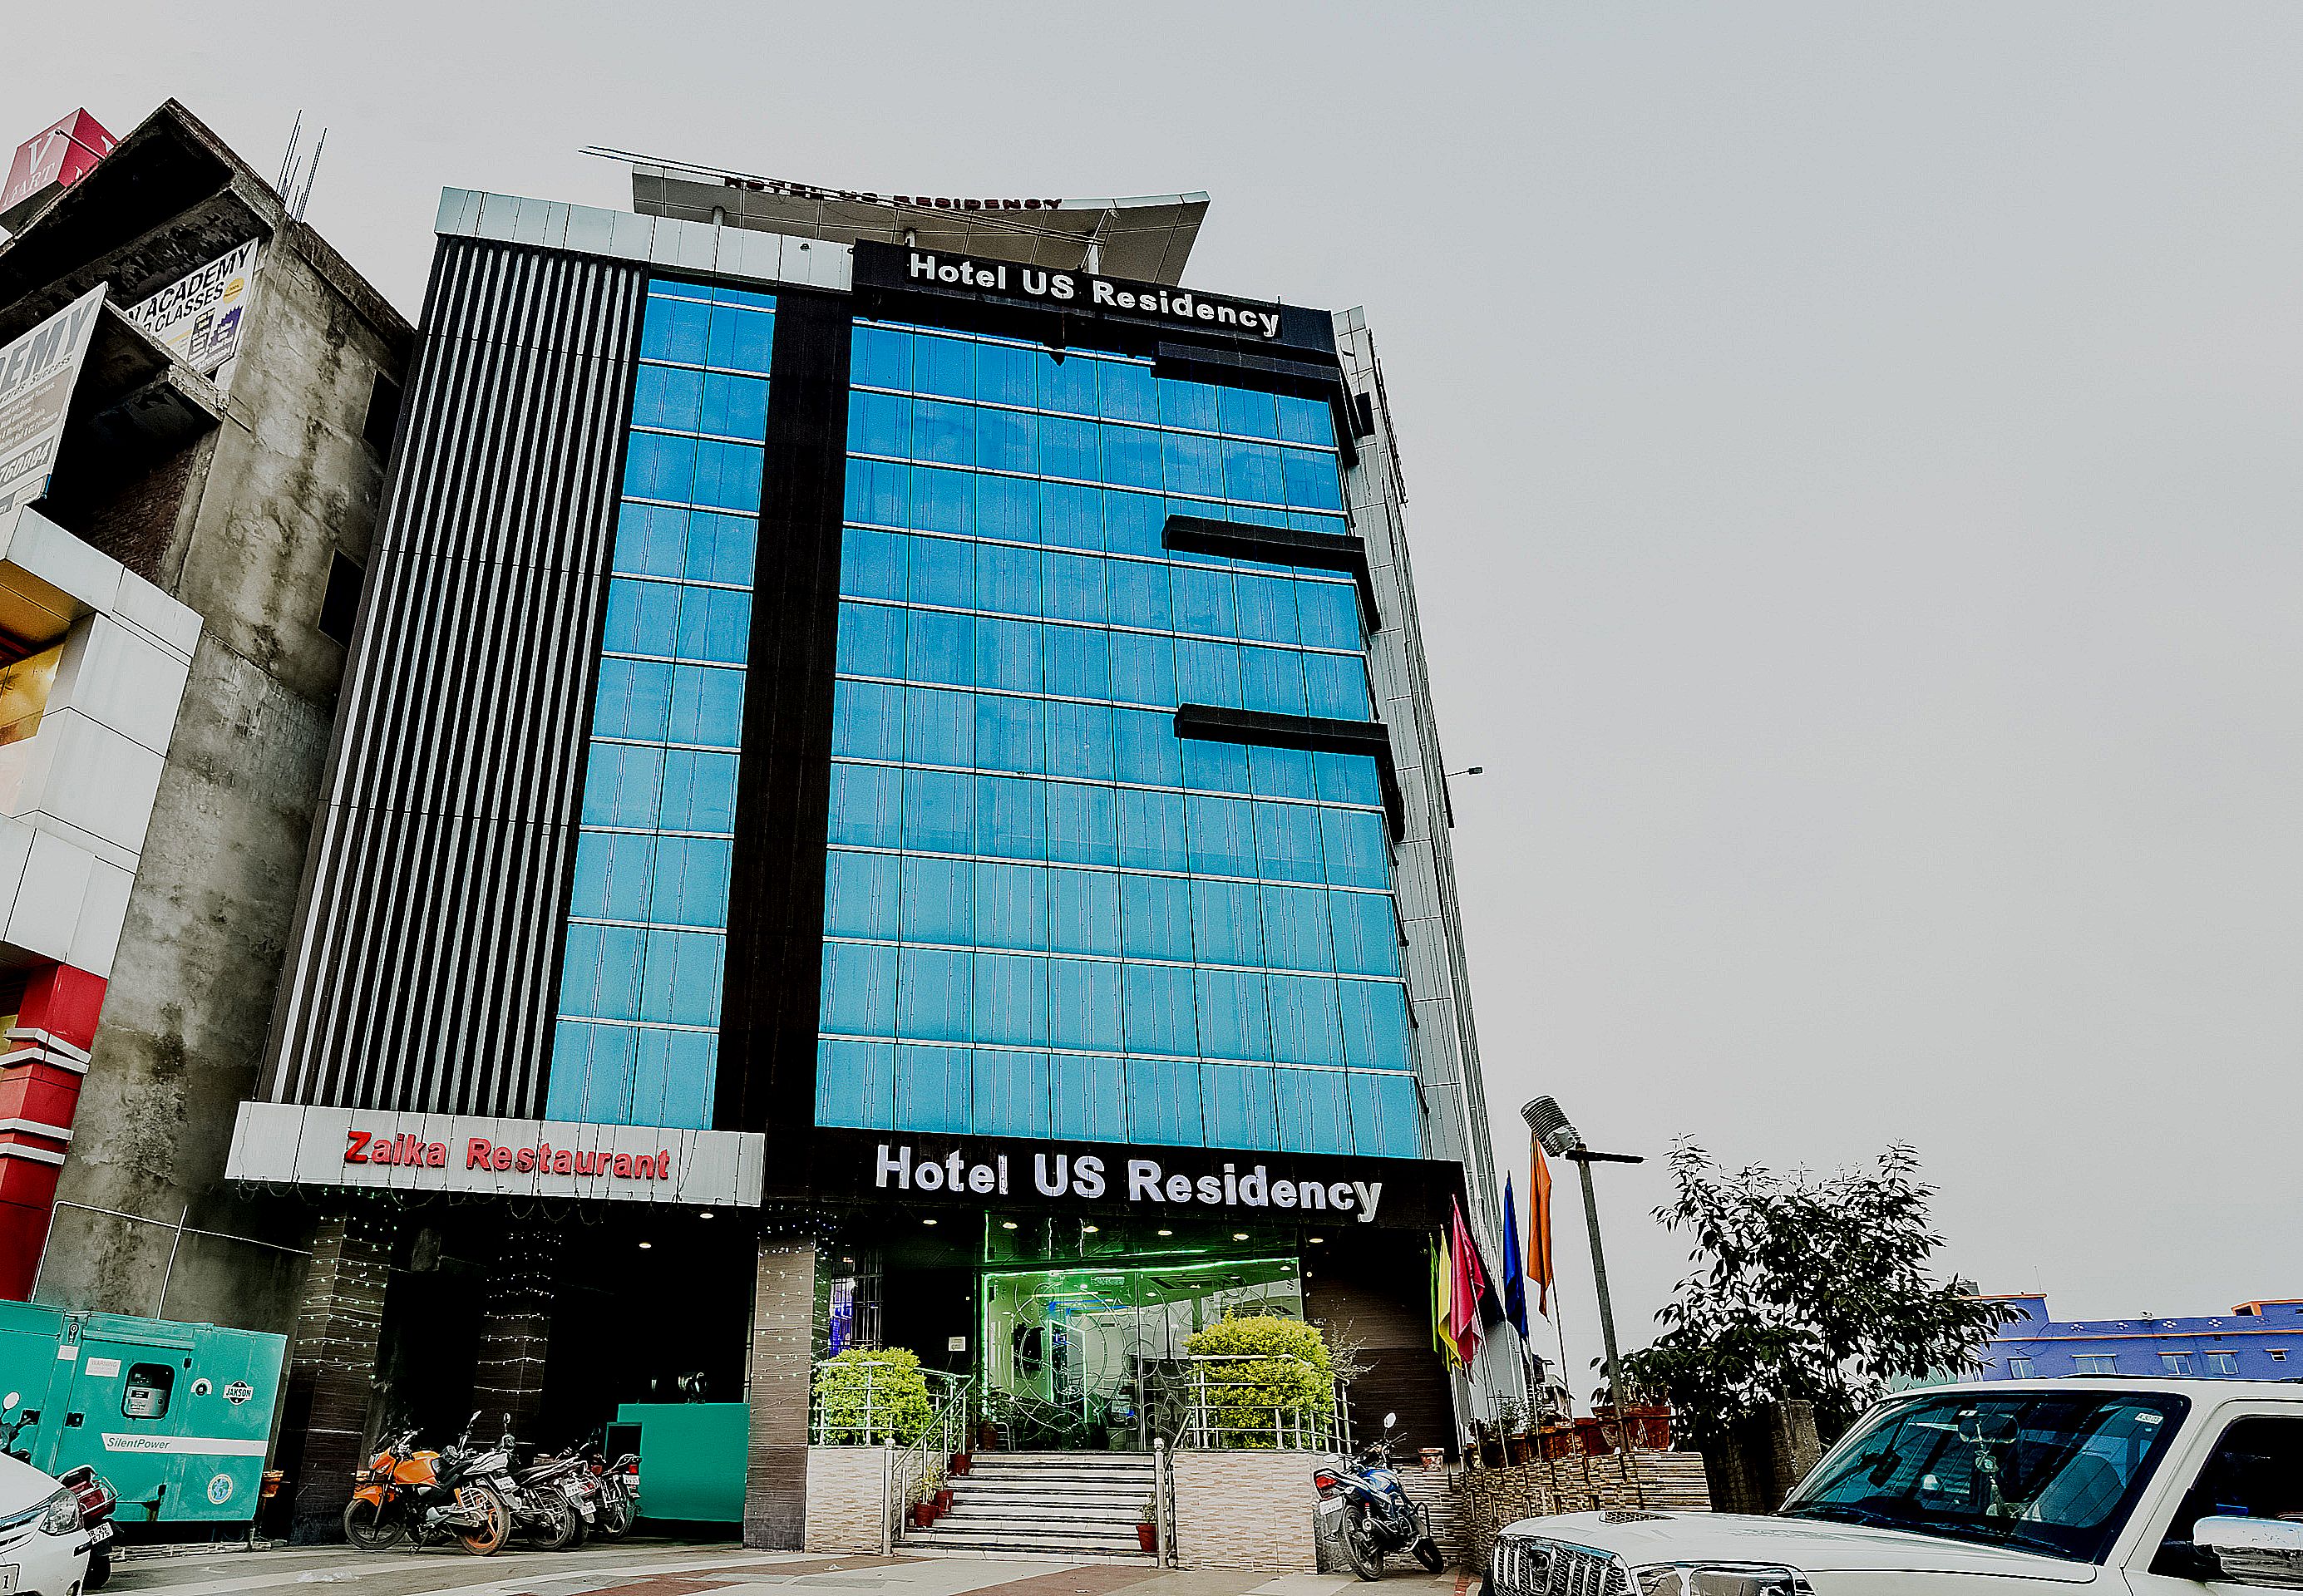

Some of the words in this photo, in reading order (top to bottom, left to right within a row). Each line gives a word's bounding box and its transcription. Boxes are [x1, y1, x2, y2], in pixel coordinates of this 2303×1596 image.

[28, 127, 62, 175] V
[893, 195, 1063, 209] RESIDENCY
[143, 242, 254, 323] ACADEMY
[155, 281, 224, 333] CLASSES
[909, 252, 1007, 289] Hotel
[1022, 268, 1075, 300] US
[1092, 280, 1280, 337] Residency
[343, 1130, 446, 1165] Zaika
[466, 1136, 670, 1181] Restaurant
[875, 1144, 1008, 1195] Hotel
[1034, 1153, 1106, 1199] US
[1128, 1159, 1382, 1223] Residency
[225, 1387, 252, 1397] JAKSON
[106, 1437, 170, 1450] SilentPower
